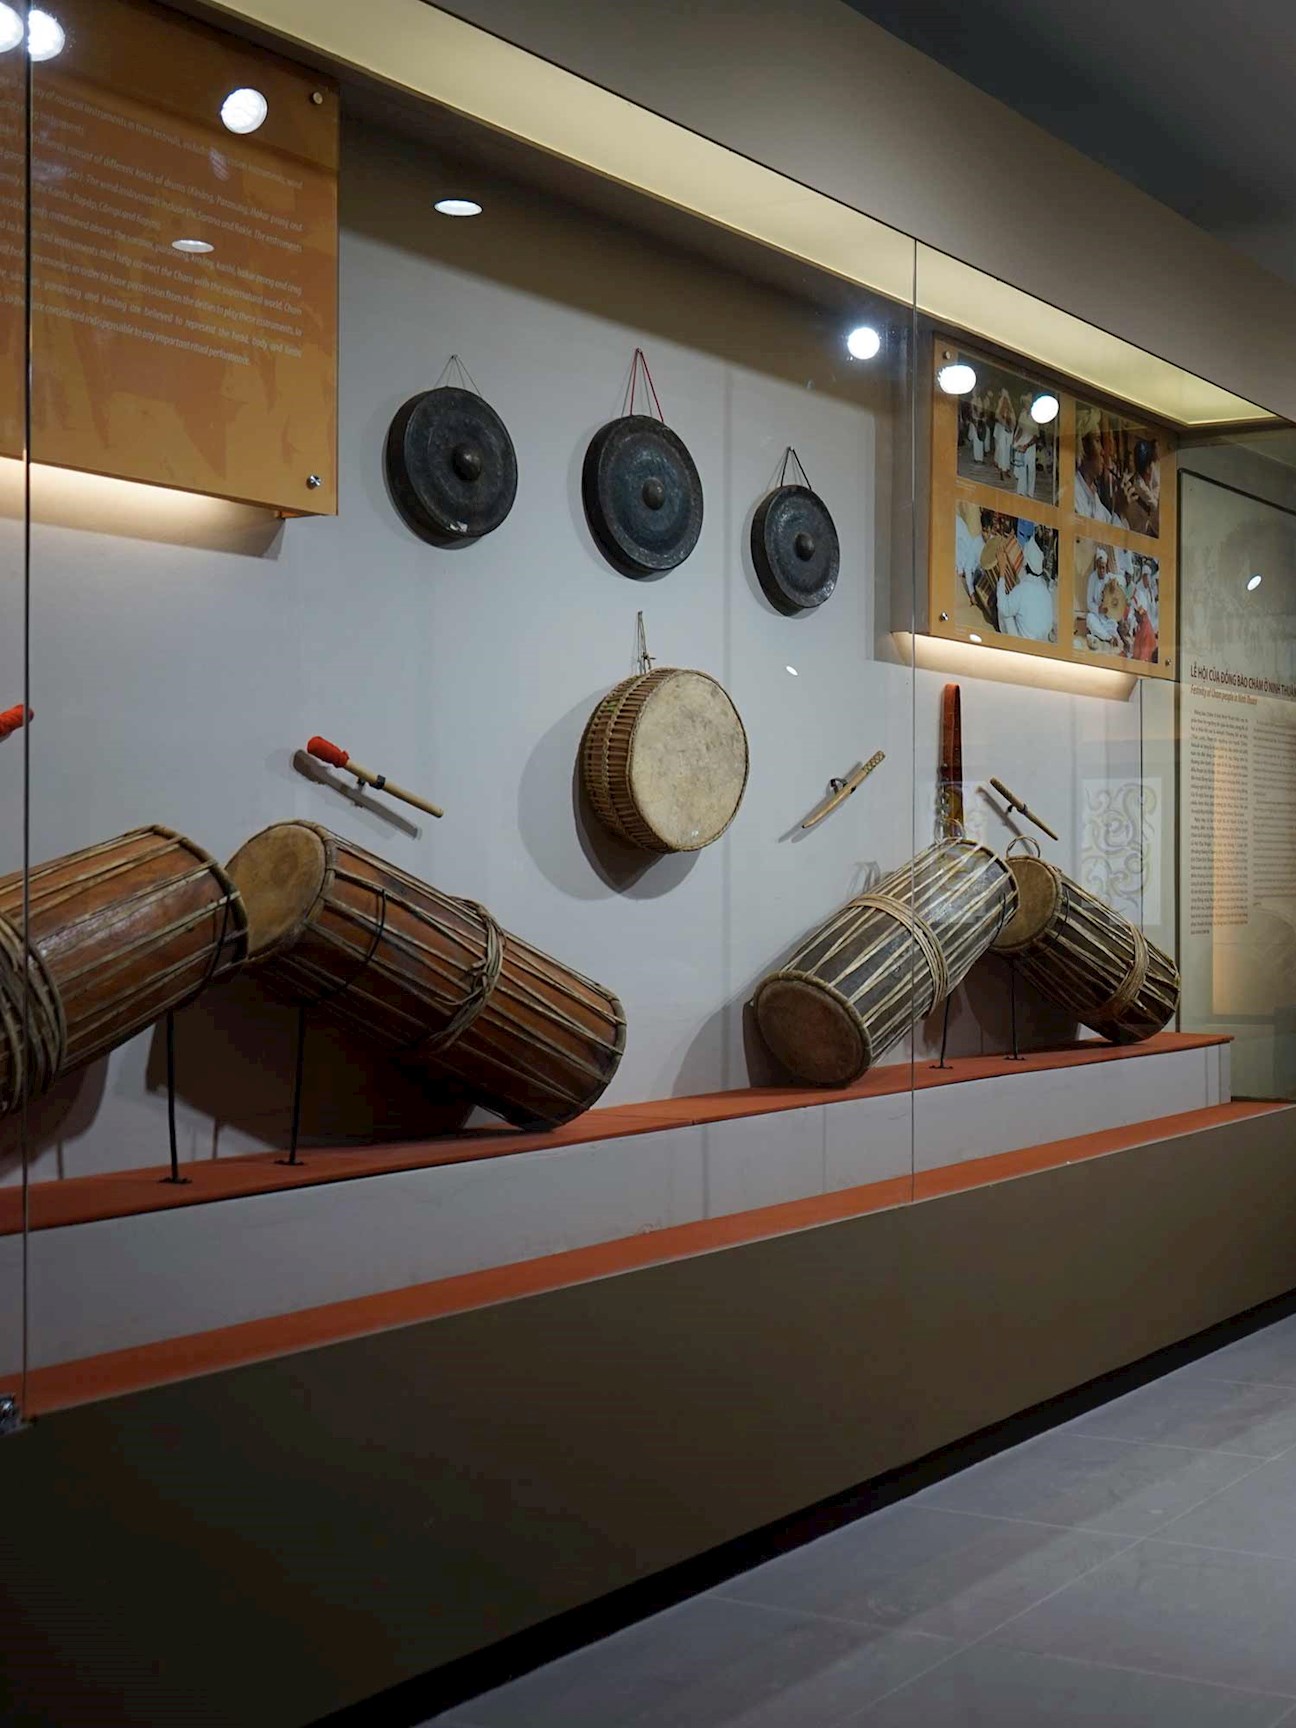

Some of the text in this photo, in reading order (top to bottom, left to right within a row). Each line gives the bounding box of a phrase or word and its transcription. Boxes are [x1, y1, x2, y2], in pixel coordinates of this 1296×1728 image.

[84, 104, 126, 127] instruments
[103, 157, 133, 175] different
[135, 167, 153, 182] kinds
[54, 234, 97, 255] instruments
[99, 247, 115, 261] that
[116, 252, 132, 268] help
[161, 266, 172, 278] the
[174, 271, 193, 284] Cham
[194, 276, 209, 290] with
[210, 281, 221, 293] the
[284, 304, 301, 317] Cham
[100, 270, 108, 282] to
[127, 279, 164, 297] permission
[165, 289, 181, 303] from
[182, 294, 193, 307] the
[216, 304, 223, 315] to
[223, 306, 237, 321] play
[45, 301, 84, 320] considered
[85, 313, 133, 333] indispensable
[155, 332, 189, 349] important
[190, 341, 208, 355] ritual
[84, 290, 99, 303] and
[144, 306, 173, 323] believed
[175, 314, 182, 327] to
[184, 320, 216, 336] represent
[218, 327, 230, 341] the
[251, 337, 267, 353] body
